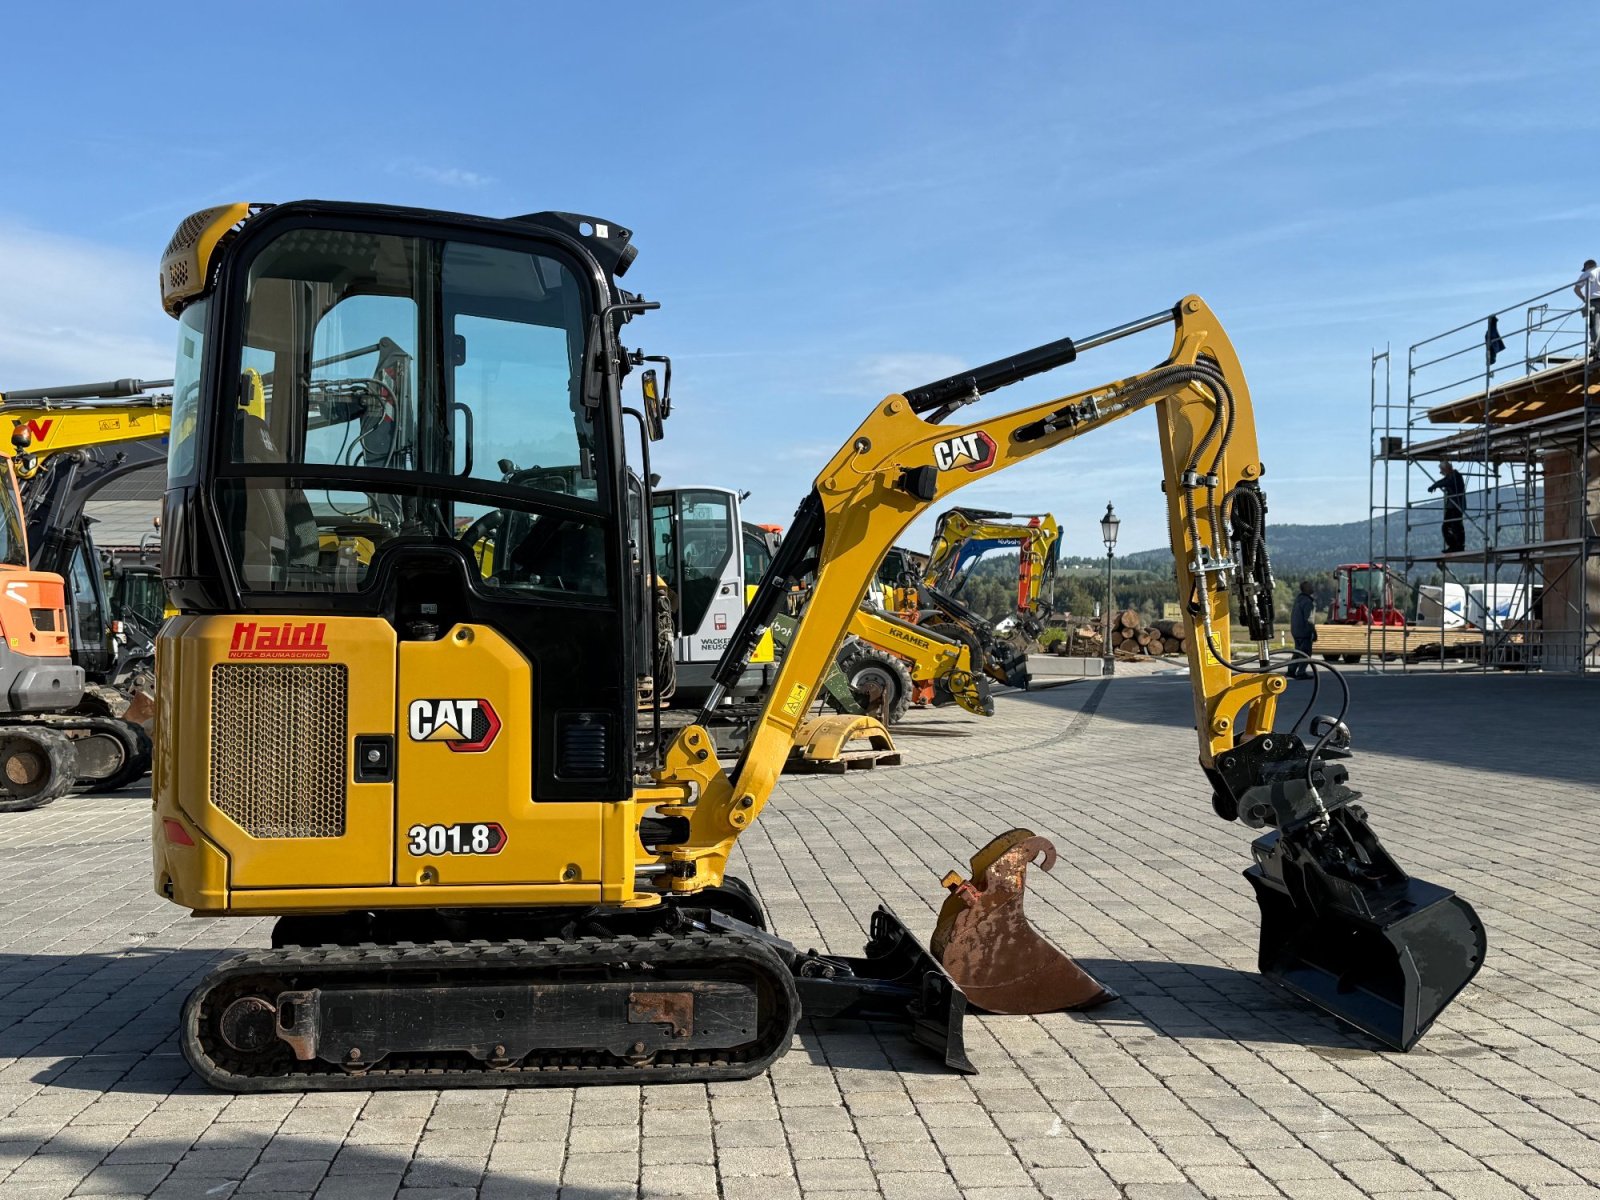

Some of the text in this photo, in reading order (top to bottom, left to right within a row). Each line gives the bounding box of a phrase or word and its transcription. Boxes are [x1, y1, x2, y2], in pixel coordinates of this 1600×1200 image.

[934, 432, 979, 471] CAT
[230, 622, 328, 651] Haidl
[889, 627, 930, 650] KRAMER
[409, 699, 479, 741] CAT
[408, 824, 490, 855] 301.8
